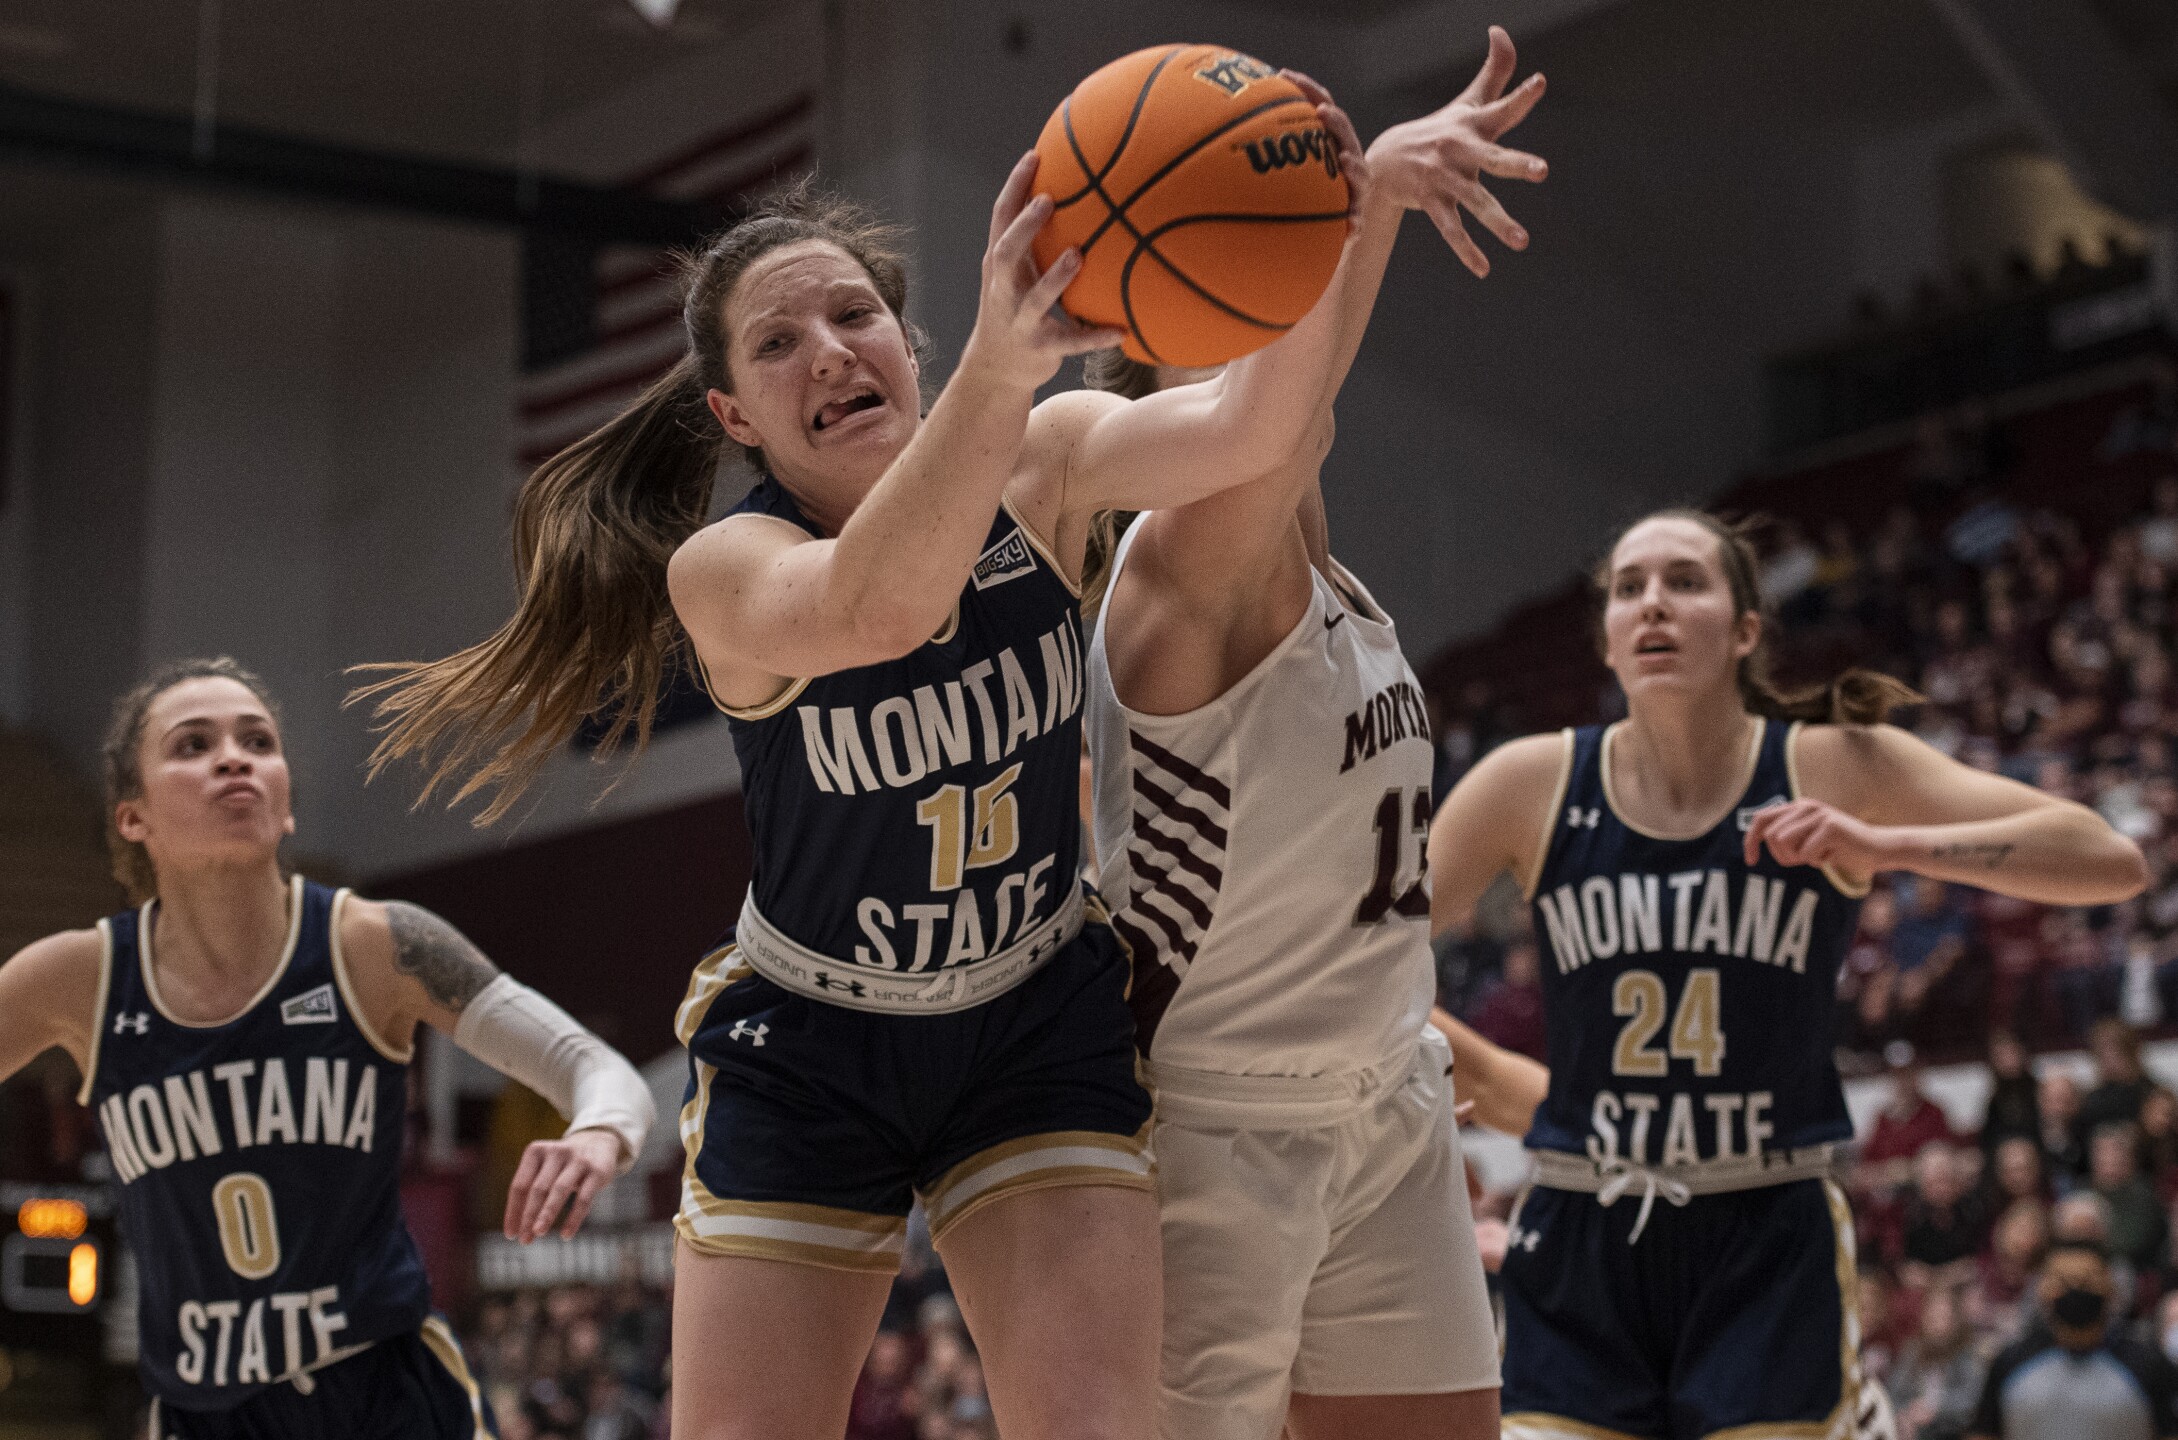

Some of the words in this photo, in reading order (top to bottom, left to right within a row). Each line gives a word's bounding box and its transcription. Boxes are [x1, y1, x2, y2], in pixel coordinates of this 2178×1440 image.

[1242, 127, 1341, 181] lson
[796, 608, 1085, 796] MONTAN
[1338, 680, 1430, 775] MONTA
[1537, 868, 1820, 975] MONTANA
[1611, 967, 1727, 1078] 24
[100, 1056, 379, 1186] MONTANA
[1586, 1090, 1774, 1168] STATE
[211, 1171, 281, 1281] 0
[176, 1285, 350, 1387] STATE
